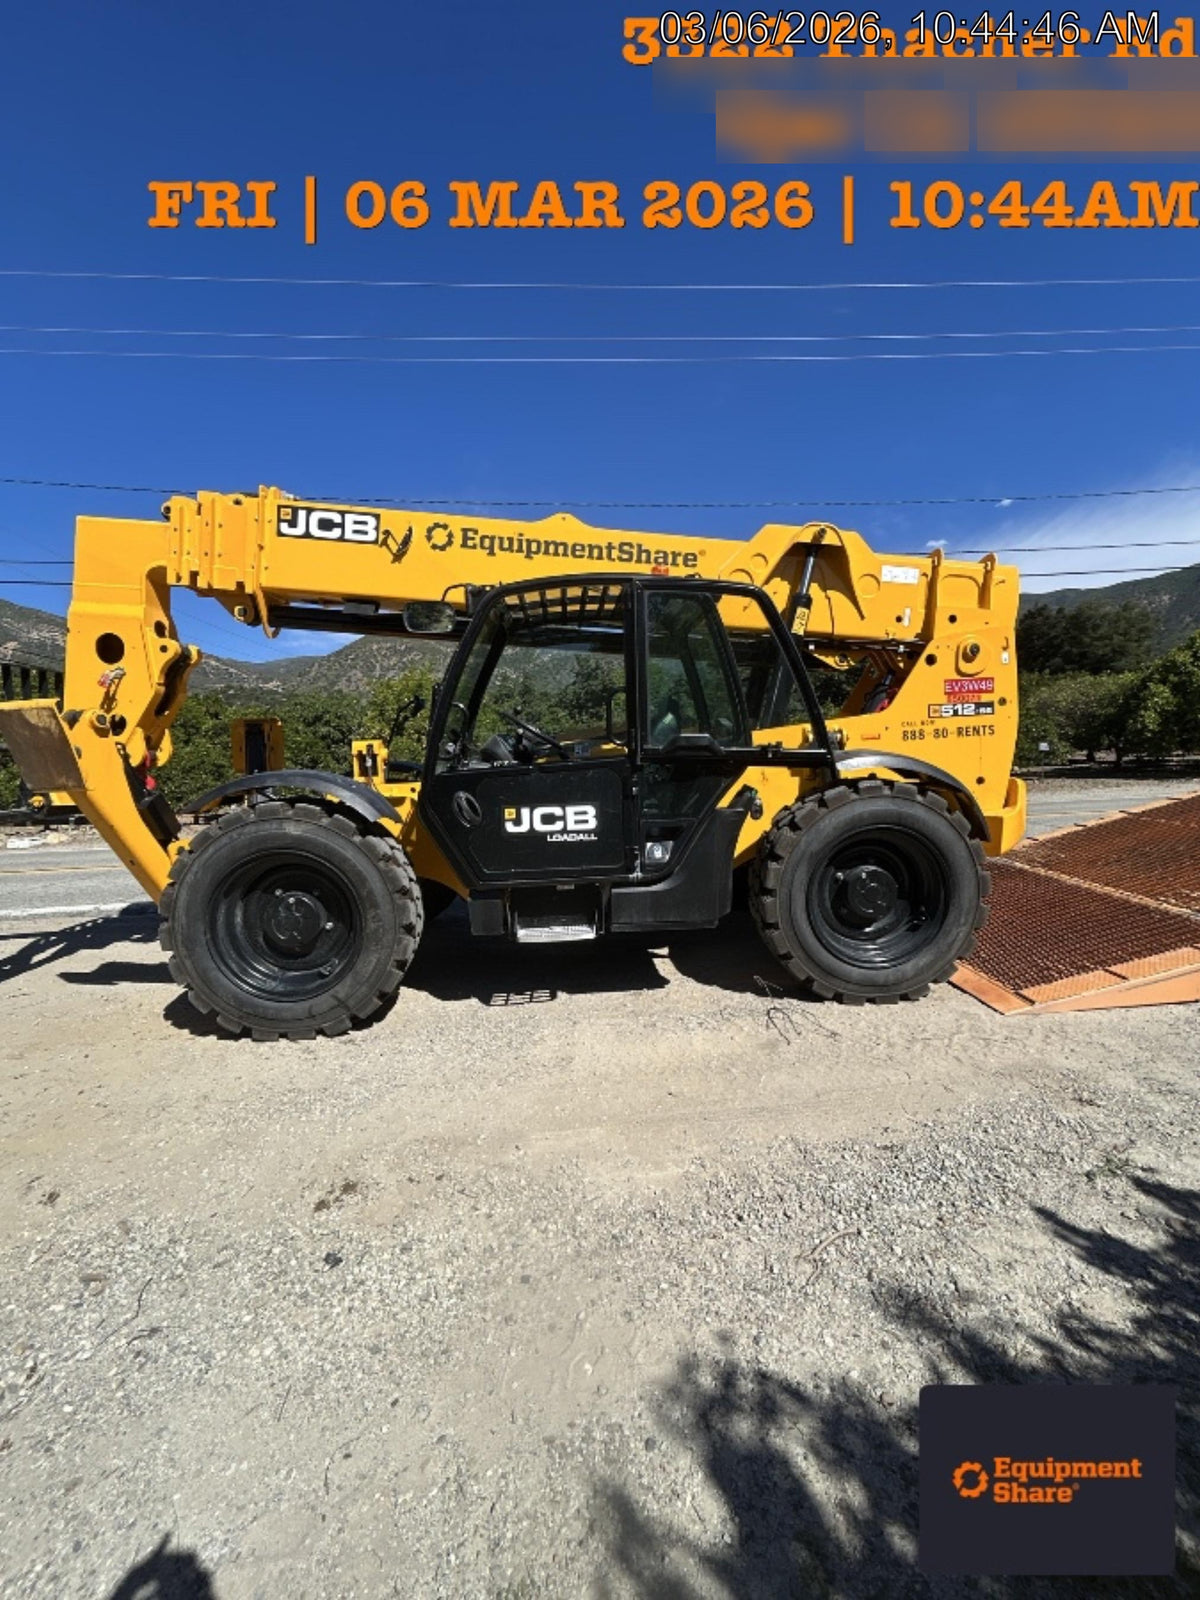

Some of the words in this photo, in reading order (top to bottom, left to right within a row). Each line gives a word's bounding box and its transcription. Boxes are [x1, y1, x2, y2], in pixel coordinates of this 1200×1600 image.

[279, 508, 378, 542] JCB
[460, 527, 699, 568] EquipmentShare
[504, 804, 598, 833] JCB
[547, 833, 598, 842] LOADALL
